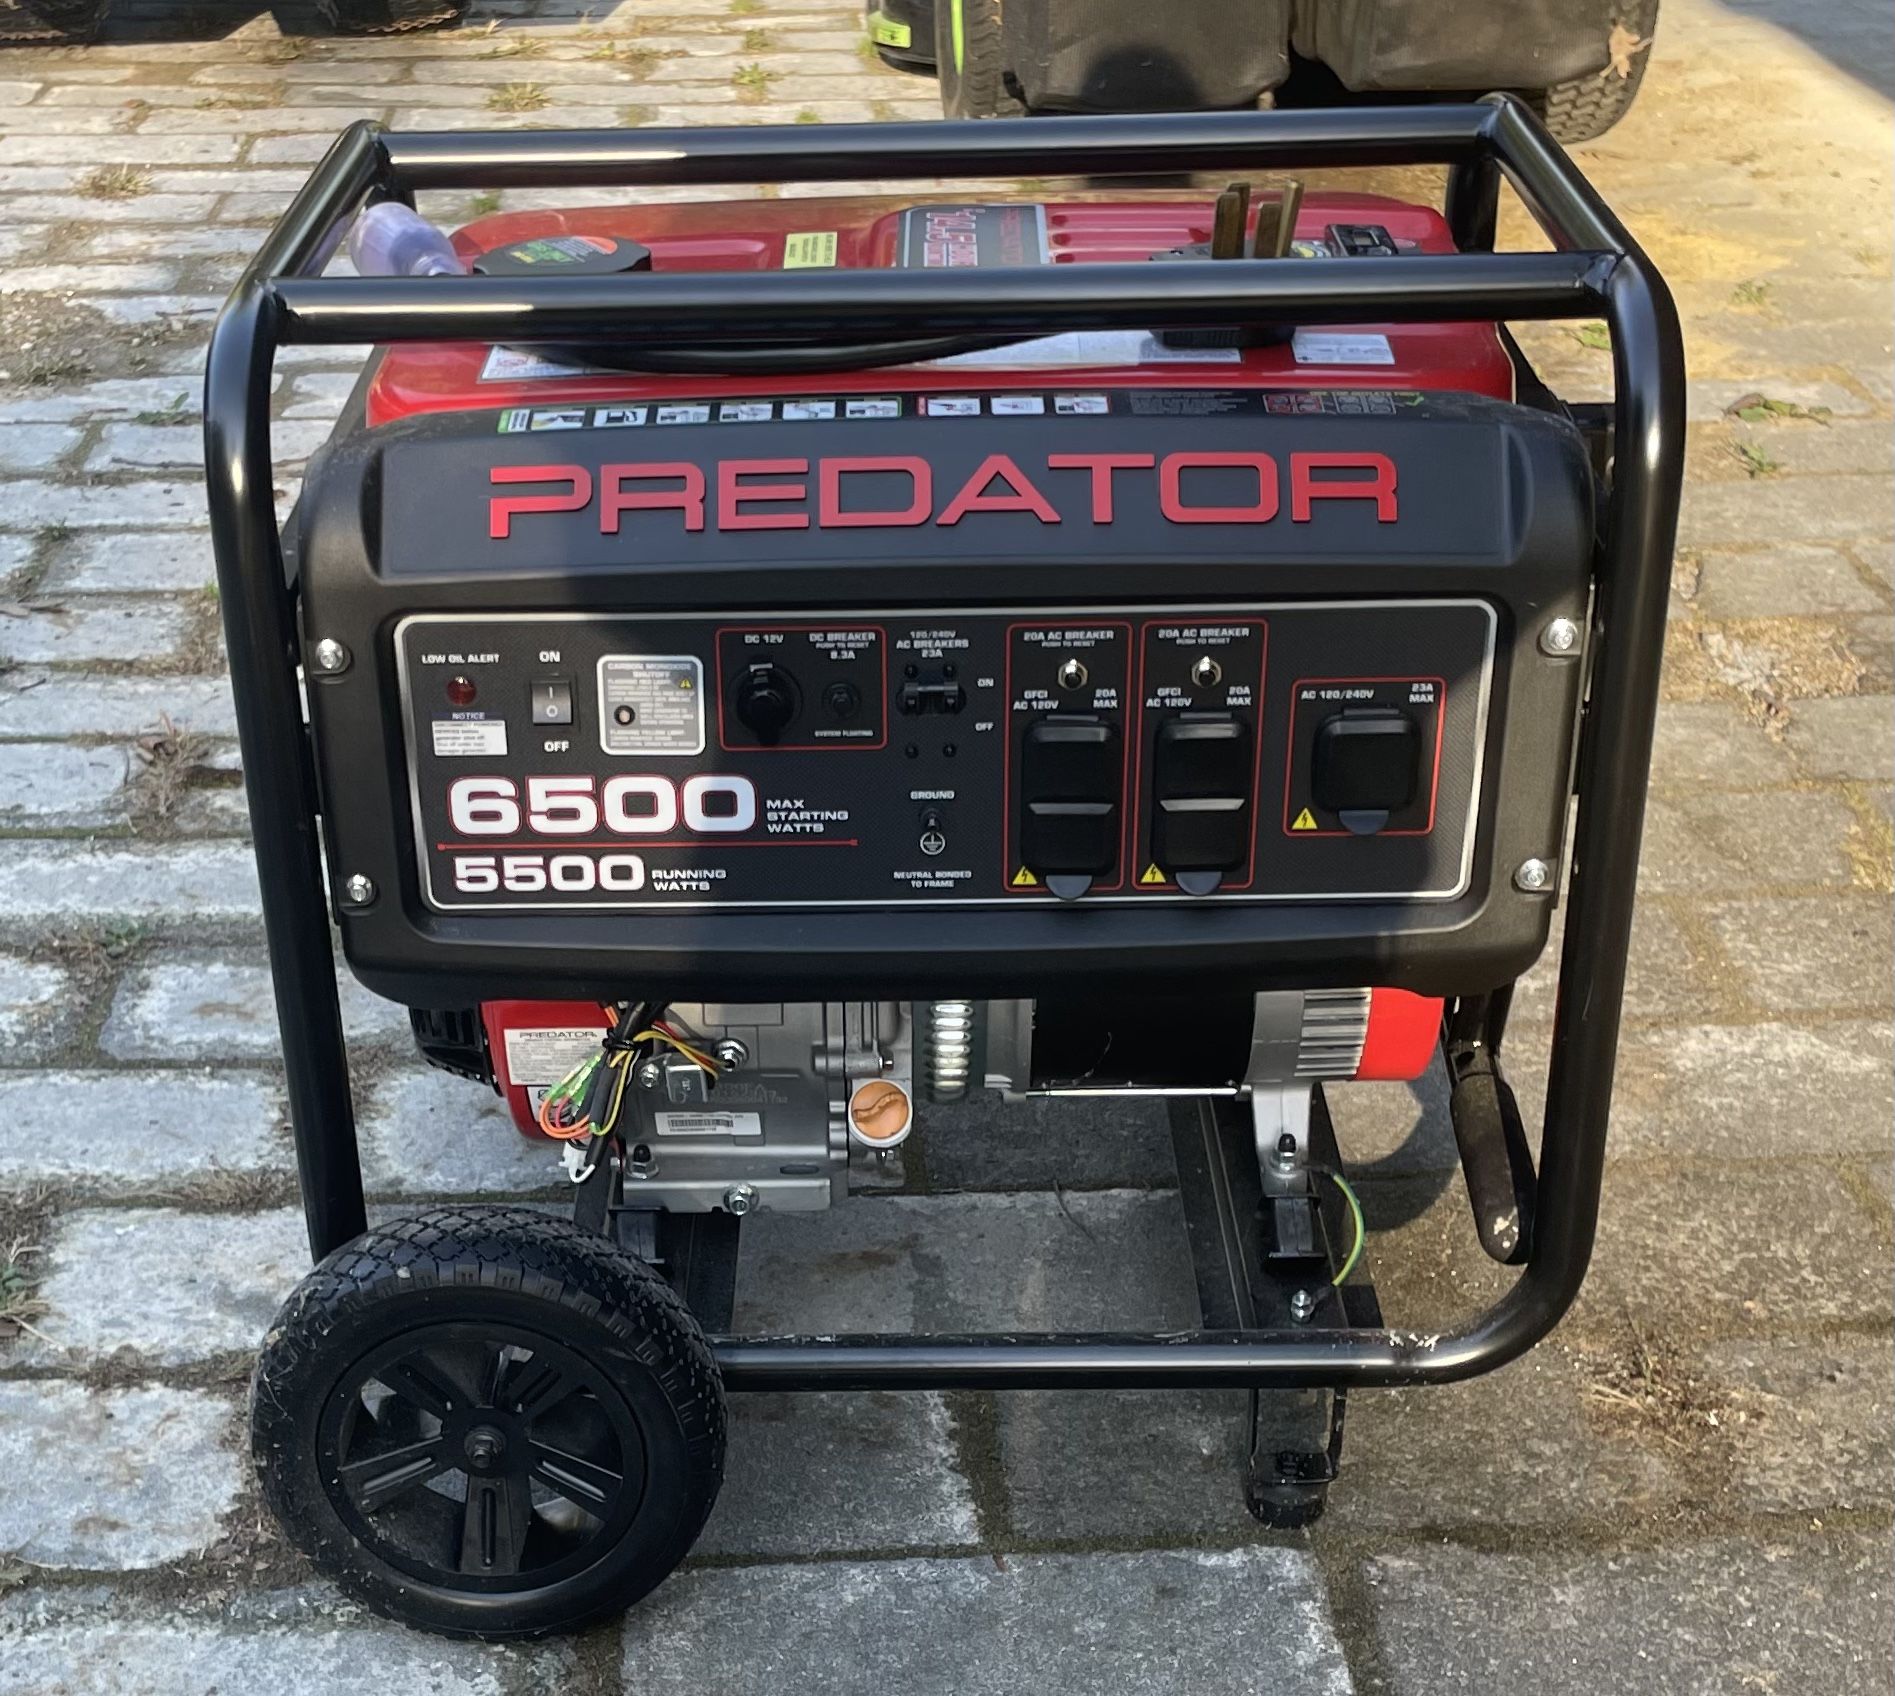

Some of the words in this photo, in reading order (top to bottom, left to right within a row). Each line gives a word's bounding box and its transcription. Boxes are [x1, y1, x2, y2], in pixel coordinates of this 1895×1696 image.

[490, 451, 1398, 538] PREDATOR
[809, 633, 824, 642] DC
[827, 632, 876, 642] BREAKER
[910, 630, 956, 639] 120/240V
[1024, 632, 1045, 641] 20A
[1047, 631, 1062, 640] AC
[1065, 630, 1114, 640] BREAKER
[1158, 629, 1180, 638] 20A
[1182, 629, 1198, 638] AC
[1200, 628, 1250, 637] BREAKER
[744, 634, 760, 644] DC
[763, 634, 784, 644] 12V
[896, 640, 911, 649] AC
[913, 639, 969, 649] BREAKERS
[422, 654, 446, 664] LOW
[448, 654, 465, 664] OIL
[467, 653, 500, 664] ALERT
[539, 651, 561, 663] ON
[922, 649, 943, 658] 23A
[977, 678, 994, 687] ON
[1412, 683, 1434, 692] 23A
[1024, 690, 1048, 699] GFCI
[1095, 688, 1117, 698] 20A
[1157, 687, 1181, 697] GFCI
[1229, 686, 1251, 695] 20A
[1301, 690, 1317, 700] AC
[1320, 689, 1374, 699] 120/240V
[1146, 698, 1161, 707] AC
[1165, 697, 1192, 707] 120V
[1226, 697, 1252, 706] MAX
[1409, 694, 1434, 703] MAX
[1013, 701, 1028, 710] AC
[1031, 700, 1059, 710] 120V
[1093, 699, 1118, 709] MAX
[452, 712, 485, 720] NOTICE
[975, 722, 994, 731] OFF
[544, 740, 570, 753] OFF
[910, 791, 955, 800] GROUND
[447, 772, 760, 837] 6500
[766, 798, 805, 810] MAX
[766, 810, 849, 822] STARTING
[767, 822, 825, 834] WATTS
[453, 853, 646, 893] 5500
[652, 868, 727, 880] RUNNING
[893, 871, 933, 879] NEUTRAL
[935, 870, 972, 879] BONDED
[653, 881, 711, 892] WATTS
[911, 880, 923, 888] TO
[924, 880, 955, 888] FRAME
